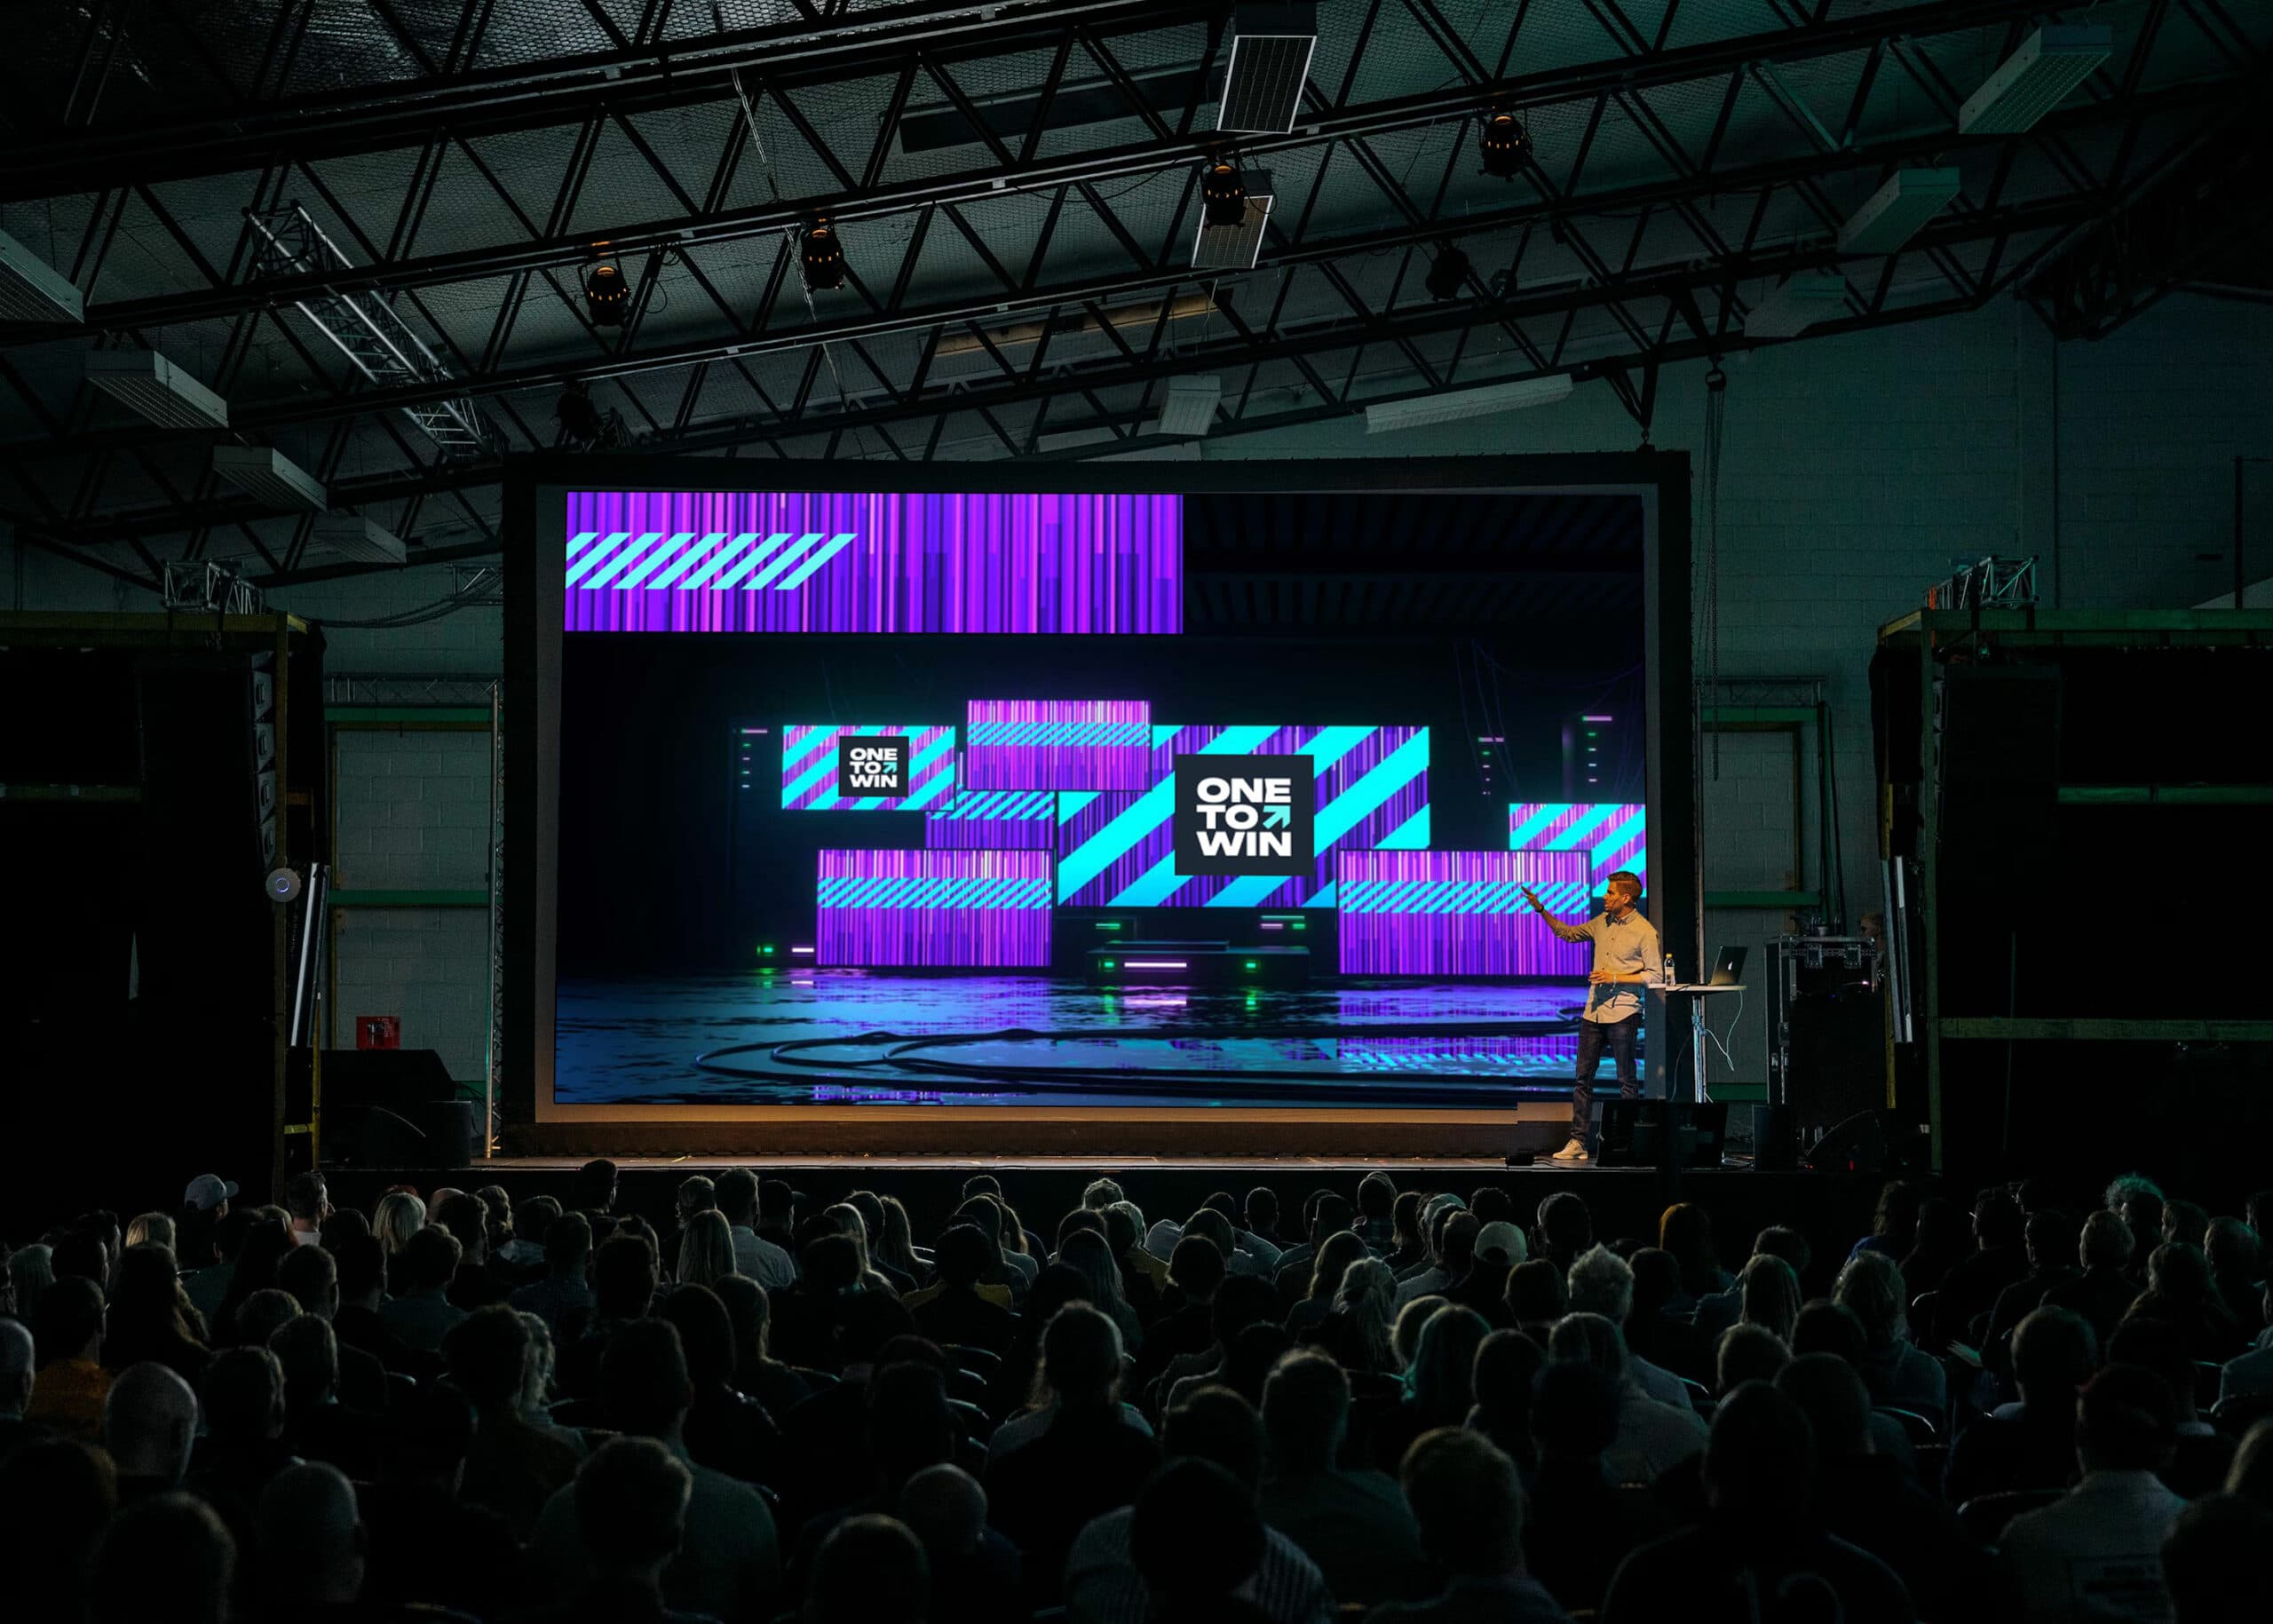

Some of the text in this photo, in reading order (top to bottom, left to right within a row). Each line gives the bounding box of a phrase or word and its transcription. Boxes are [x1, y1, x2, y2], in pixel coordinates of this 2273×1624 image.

[850, 748, 898, 761] ONE
[850, 761, 881, 774] TO
[849, 774, 898, 788] WIN
[1196, 777, 1292, 804] ONE
[1196, 804, 1259, 830] TO
[1196, 830, 1292, 857] WIN
